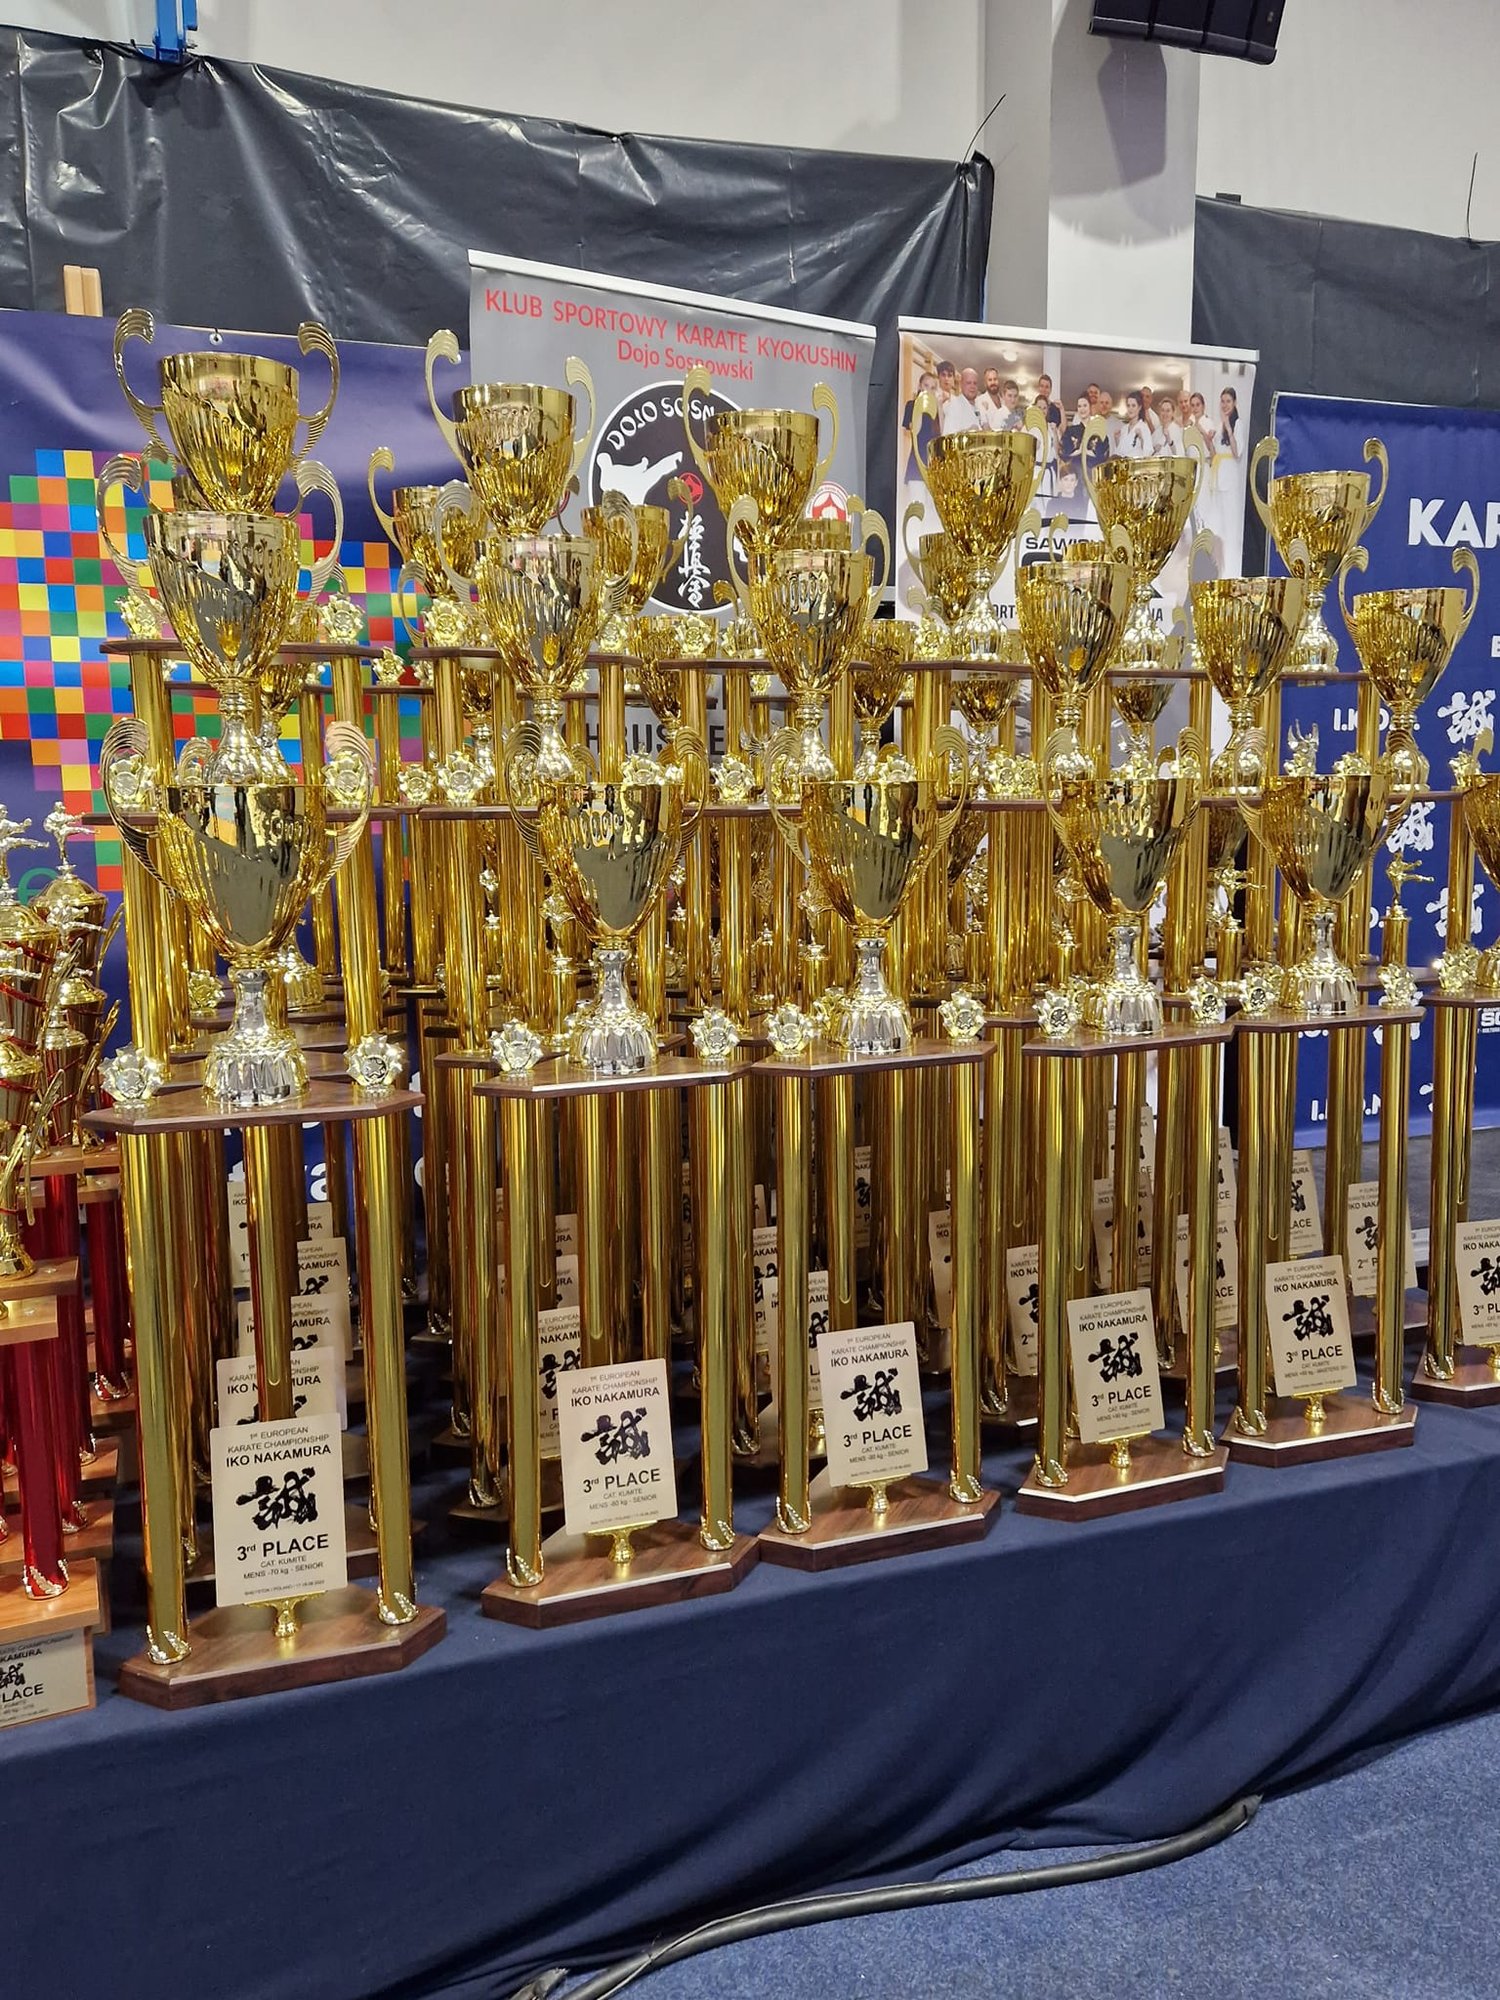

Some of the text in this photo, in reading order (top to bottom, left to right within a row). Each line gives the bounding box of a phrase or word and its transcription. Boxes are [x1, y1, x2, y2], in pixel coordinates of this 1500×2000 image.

[486, 289, 857, 373] KLUB SPORTOWY KARATE KYOKUSHIN
[618, 339, 659, 368] Dojo
[607, 401, 657, 450] DOJO
[1463, 1242, 1477, 1250] IKO
[299, 1259, 340, 1271] KAMURA
[1010, 1269, 1024, 1278] IKO
[1274, 1278, 1338, 1293] IKO NAKAMURA
[1100, 1300, 1132, 1309] EUROPEAN
[292, 1317, 331, 1328] AMURA
[1079, 1314, 1148, 1332] IKO NAKAMURA
[855, 1333, 891, 1344] EUROPEAN
[832, 1340, 907, 1355] KARATE CHAMPIONSHIP
[1302, 1345, 1342, 1360] PLACE
[831, 1349, 909, 1368] IKO NAKAMURA
[600, 1370, 640, 1381] EUROPEAN
[227, 1384, 249, 1395] IKO
[572, 1377, 658, 1394] KARATE CHAMPIONSHIP
[571, 1387, 660, 1407] IKO NAKAMURA
[1109, 1386, 1152, 1403] PLACE
[260, 1426, 308, 1438] EUROPEAN
[843, 1425, 912, 1447] 3rd PLACE
[228, 1434, 329, 1453] KARATE CHAMPIONSHIP
[226, 1444, 331, 1468] IKO NAKAMURA
[584, 1468, 660, 1493] 3rd PLACE
[237, 1534, 329, 1561] 3rd PLACE
[278, 1555, 306, 1565] KUMITE
[244, 1570, 265, 1579] MENS
[295, 1561, 323, 1572] SENIOR
[0, 1649, 42, 1663] KAMURA
[2, 1683, 44, 1702] LACE
